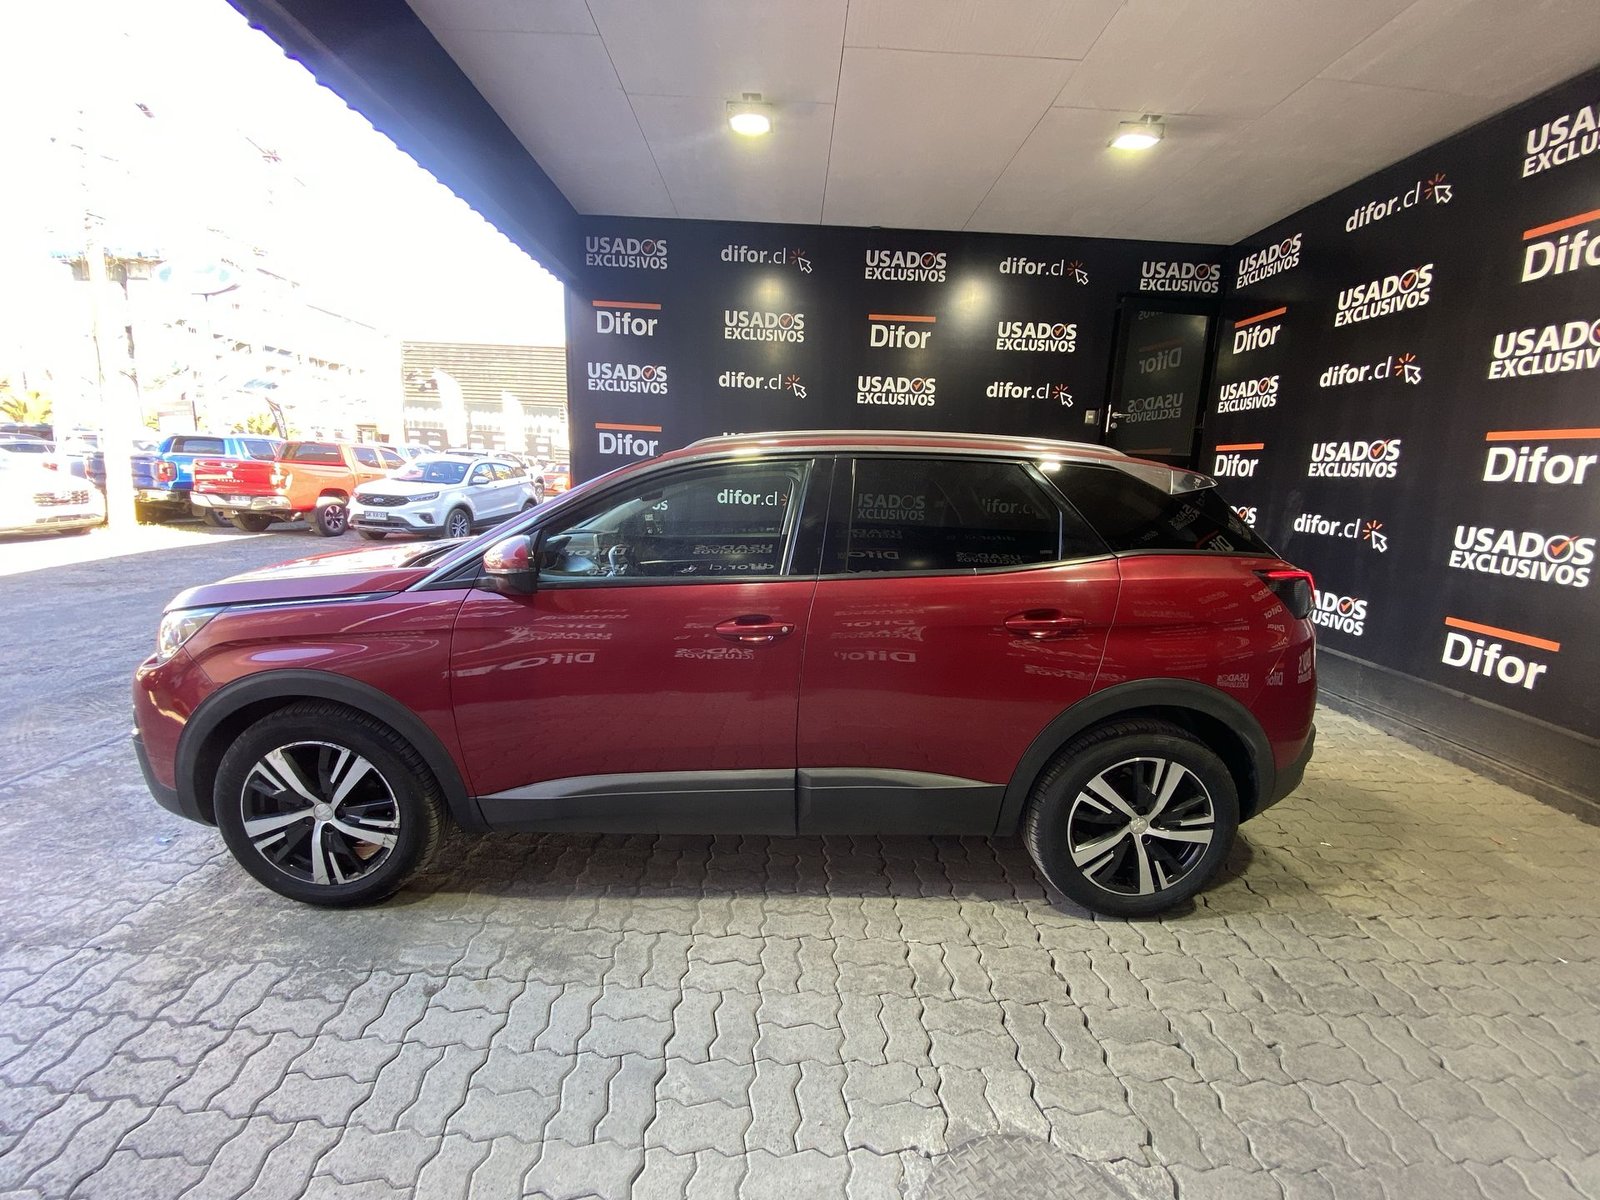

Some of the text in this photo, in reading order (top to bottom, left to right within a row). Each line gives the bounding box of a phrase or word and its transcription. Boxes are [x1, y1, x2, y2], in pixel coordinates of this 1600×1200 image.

[1526, 105, 1600, 155] USA
[1522, 131, 1600, 178] EXCLU
[1345, 181, 1421, 233] difor.cl
[585, 235, 668, 257] USADOS
[720, 245, 787, 265] difor.cl
[1238, 232, 1302, 275] USADOS
[585, 253, 668, 270] EXCLUSIVOS
[865, 249, 947, 270] USADOS
[999, 257, 1065, 277] difor.cl
[1236, 253, 1300, 289] EXCLUSIVOS
[864, 267, 946, 283] EXCLUSIVOS
[1141, 261, 1221, 282] USADOS
[1139, 278, 1219, 294] EXCLUSIVOS
[1337, 264, 1433, 311] USADOS
[1334, 287, 1431, 327] EXCLUSIVOS
[596, 310, 658, 337] Difor
[724, 310, 805, 331] USADOS
[997, 321, 1077, 341] USADOS
[724, 327, 805, 343] EXCLUSIVOS
[870, 324, 931, 349] Difor
[996, 338, 1076, 352] EXCLUSIVOS
[1233, 323, 1281, 355] Difor
[587, 361, 668, 382] USADOS
[718, 371, 782, 390] difor.cl
[1319, 356, 1392, 387] difor.cl
[588, 378, 668, 395] EXCLUSIVOS
[857, 375, 936, 395] USADOS
[986, 381, 1050, 400] difor.cl
[1219, 374, 1279, 401] USADOS
[856, 392, 935, 407] EXCLUSIVOS
[1217, 393, 1277, 413] EXCLUSIVOS
[599, 432, 658, 457] Difor
[1311, 439, 1401, 463] USADOS
[1213, 453, 1259, 477] Difor
[1308, 461, 1398, 478] EXCLUSIVOS
[1482, 446, 1597, 485] Difor
[717, 489, 778, 506] difor.cl
[857, 508, 925, 521] XCLUSIVOS
[1293, 513, 1361, 538] difor.cl
[1453, 525, 1597, 565] USADOS
[1449, 550, 1591, 588] EXCLUSIVOS
[1314, 590, 1368, 620] ADOS
[1312, 609, 1364, 636] USIVOS
[1441, 632, 1547, 690] Difor
